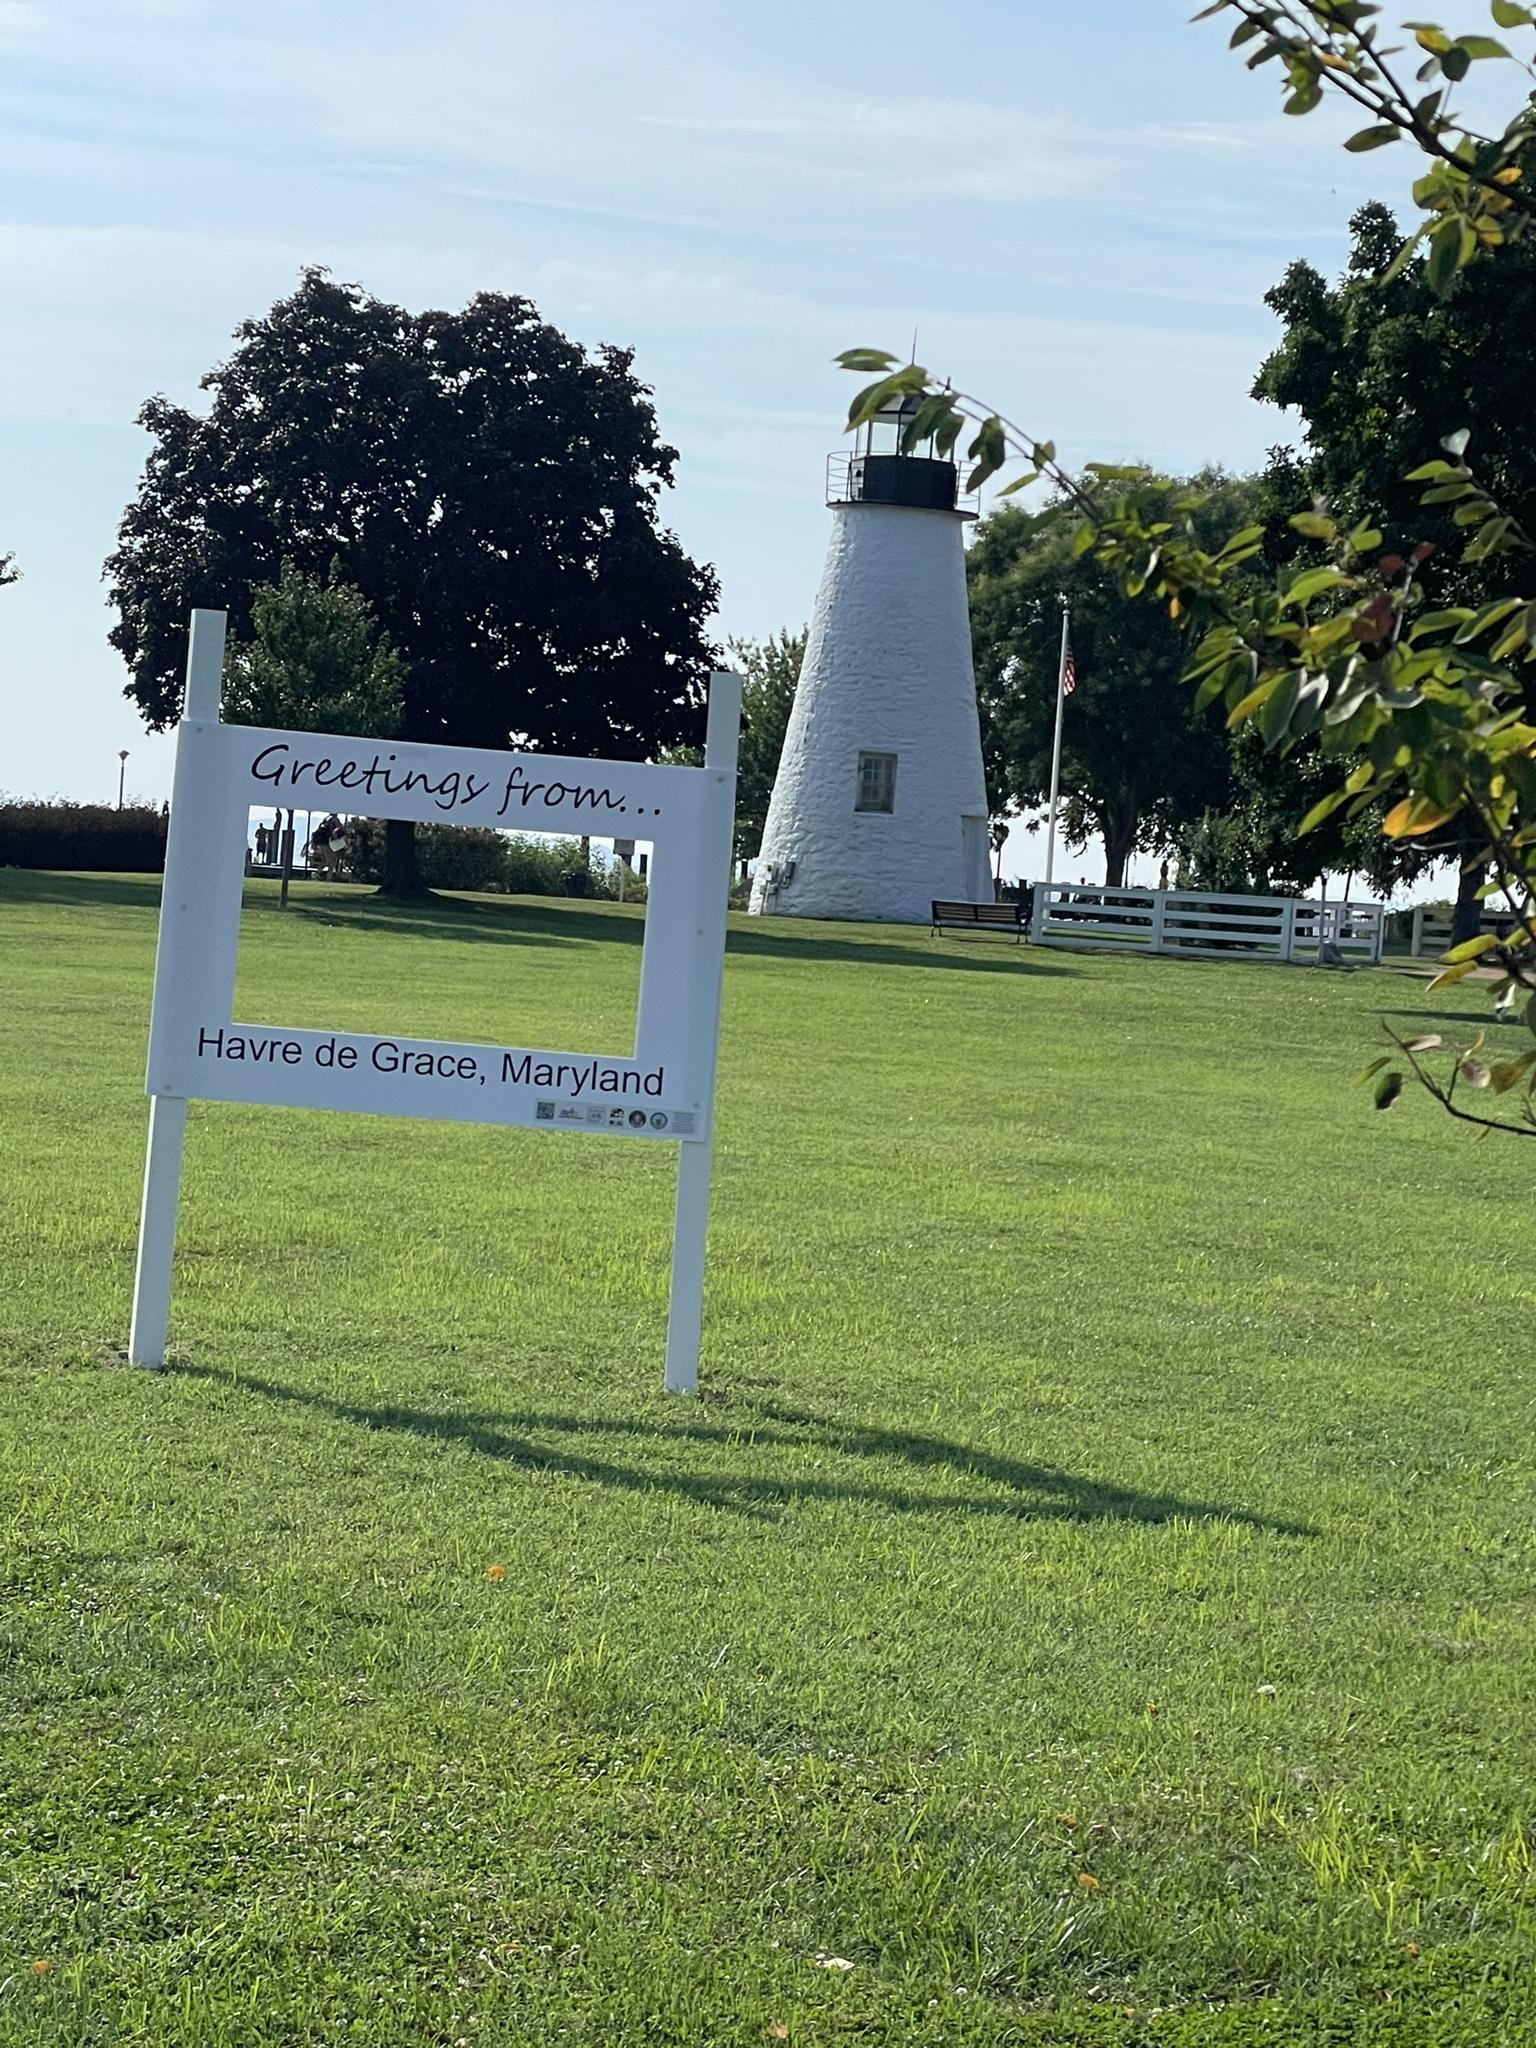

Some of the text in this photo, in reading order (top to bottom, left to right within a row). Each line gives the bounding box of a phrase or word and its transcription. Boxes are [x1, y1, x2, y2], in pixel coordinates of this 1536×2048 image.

[250, 743, 663, 817] Greetings from...
[197, 1026, 664, 1097] Havre de Grace, Maryland
